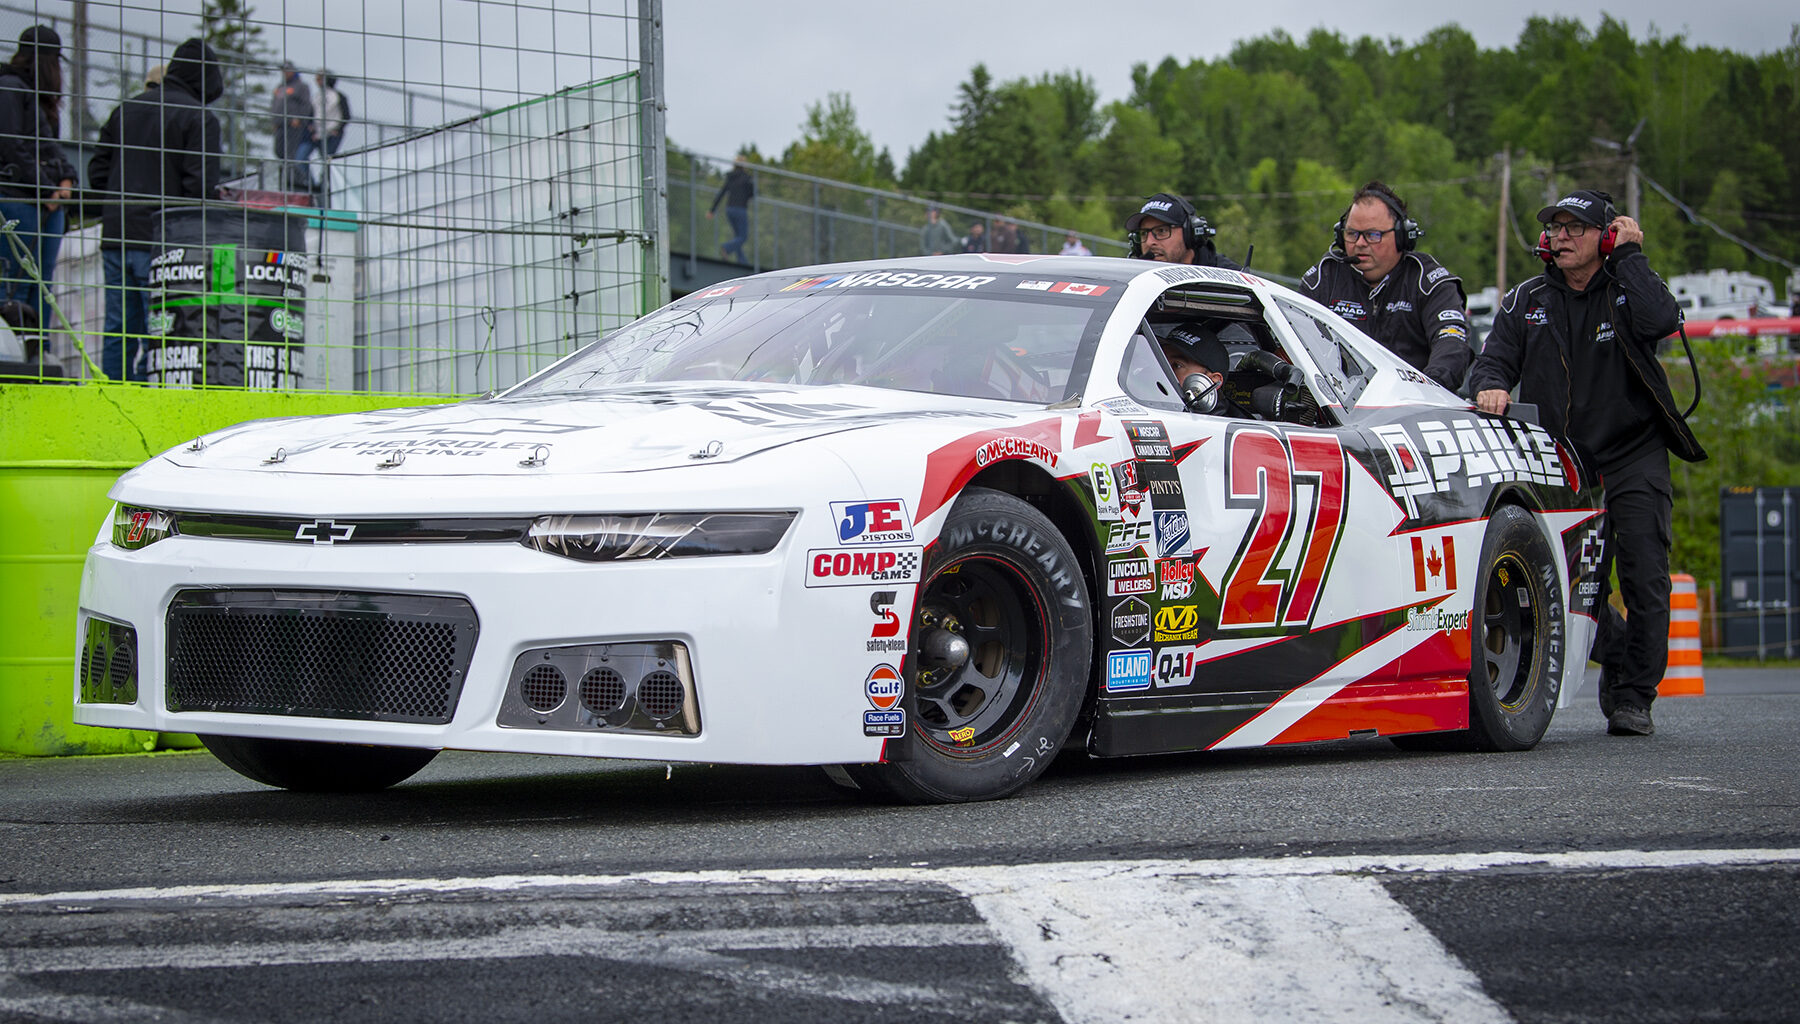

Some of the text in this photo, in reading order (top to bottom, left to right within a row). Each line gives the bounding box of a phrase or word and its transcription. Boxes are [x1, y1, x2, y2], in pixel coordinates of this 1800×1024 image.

[825, 272, 997, 290] NASCAR
[1139, 426, 1161, 438] NASCAR
[329, 439, 553, 450] CHEVROLET
[356, 448, 488, 457] RACING
[1134, 445, 1170, 456] CANADA SERIES
[1417, 418, 1565, 493] PAILLE
[1150, 480, 1181, 495] PINTY'S
[127, 512, 153, 542] 27
[840, 502, 903, 541] JE
[1218, 426, 1345, 630] 27
[861, 532, 912, 541] PISTONS
[1109, 521, 1152, 544] PFC
[813, 552, 897, 578] COMP
[1110, 561, 1148, 578] LINCOLN
[1160, 560, 1195, 584] Holley
[871, 570, 911, 581] CAMS
[1117, 578, 1152, 593] WELDERS
[1161, 583, 1193, 600] MSD
[1114, 613, 1148, 629] FRESHSTONE
[1154, 628, 1199, 643] MECHANIX WEAR
[866, 638, 906, 654] safety-kleen
[1111, 656, 1149, 679] LELAND
[1158, 652, 1194, 684] QA1
[868, 681, 900, 695] Gulf
[868, 714, 900, 722] Race Fuels
